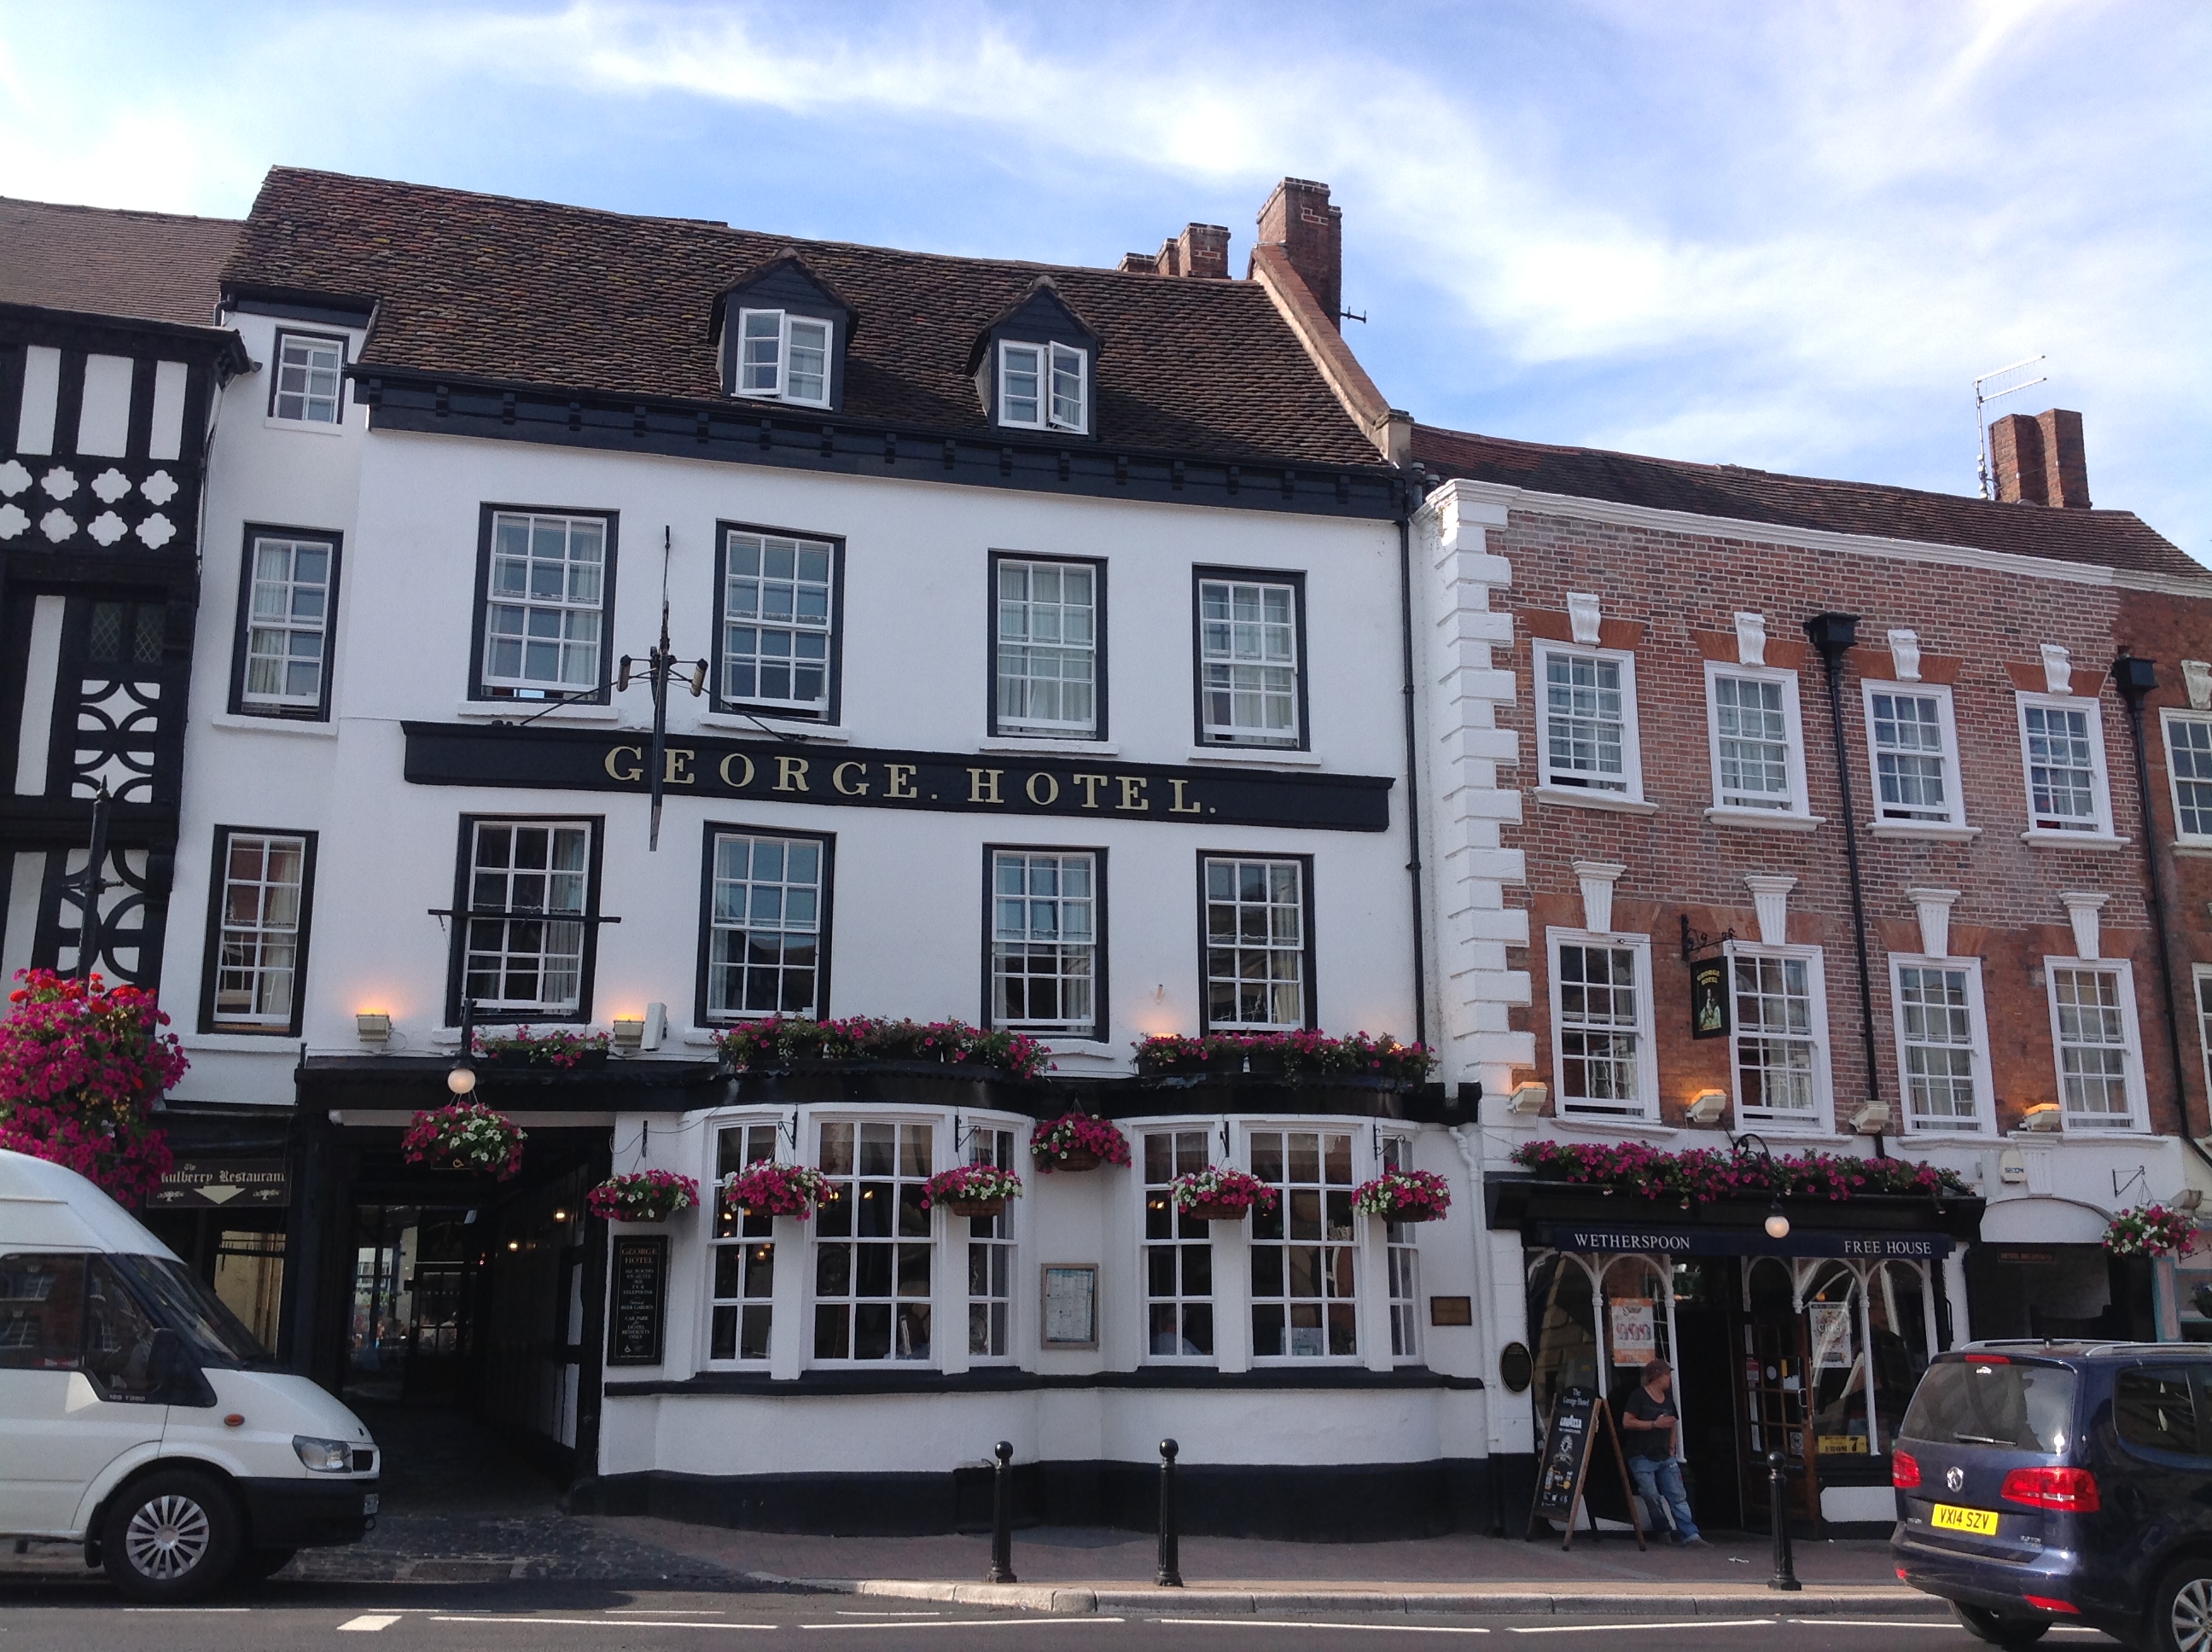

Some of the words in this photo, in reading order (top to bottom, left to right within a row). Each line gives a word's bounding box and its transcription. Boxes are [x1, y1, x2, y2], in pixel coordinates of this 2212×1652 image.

[966, 767, 1217, 814] HOTEL.
[1574, 1233, 1691, 1249] WETHERSPOON
[1843, 1240, 1882, 1254] FREE
[1886, 1241, 1932, 1254] HOUSE
[1573, 1387, 1581, 1397] The
[1940, 1507, 1963, 1524] VX14
[1965, 1511, 1990, 1529] SZV
